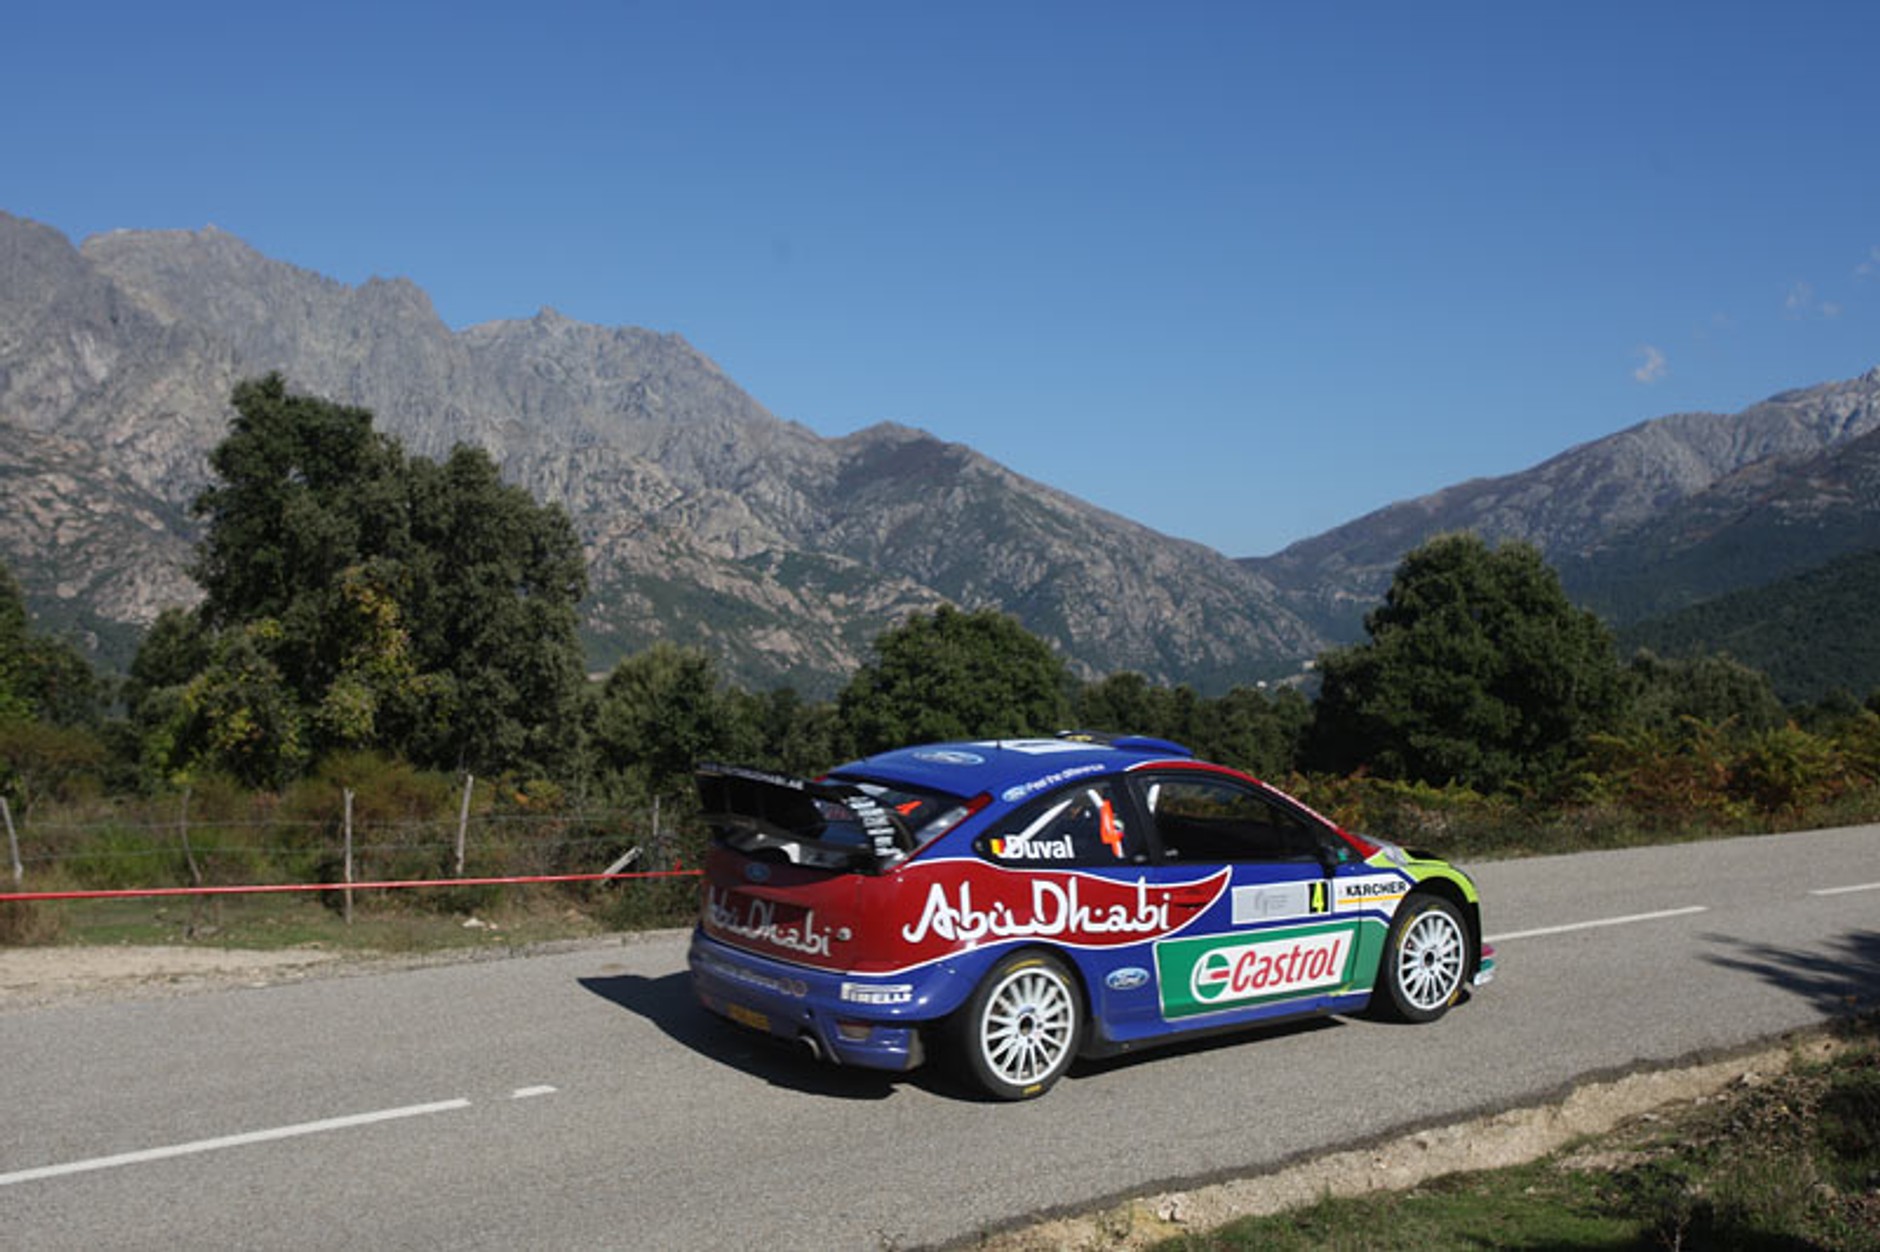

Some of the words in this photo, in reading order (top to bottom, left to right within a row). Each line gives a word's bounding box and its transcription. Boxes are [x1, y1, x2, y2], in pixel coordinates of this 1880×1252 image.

[1004, 835, 1076, 859] Duval
[902, 880, 1030, 943] Abu
[1031, 875, 1171, 935] Dhabi
[1311, 882, 1325, 914] 4
[748, 898, 832, 958] Dhabi
[1231, 939, 1341, 994] Castrol
